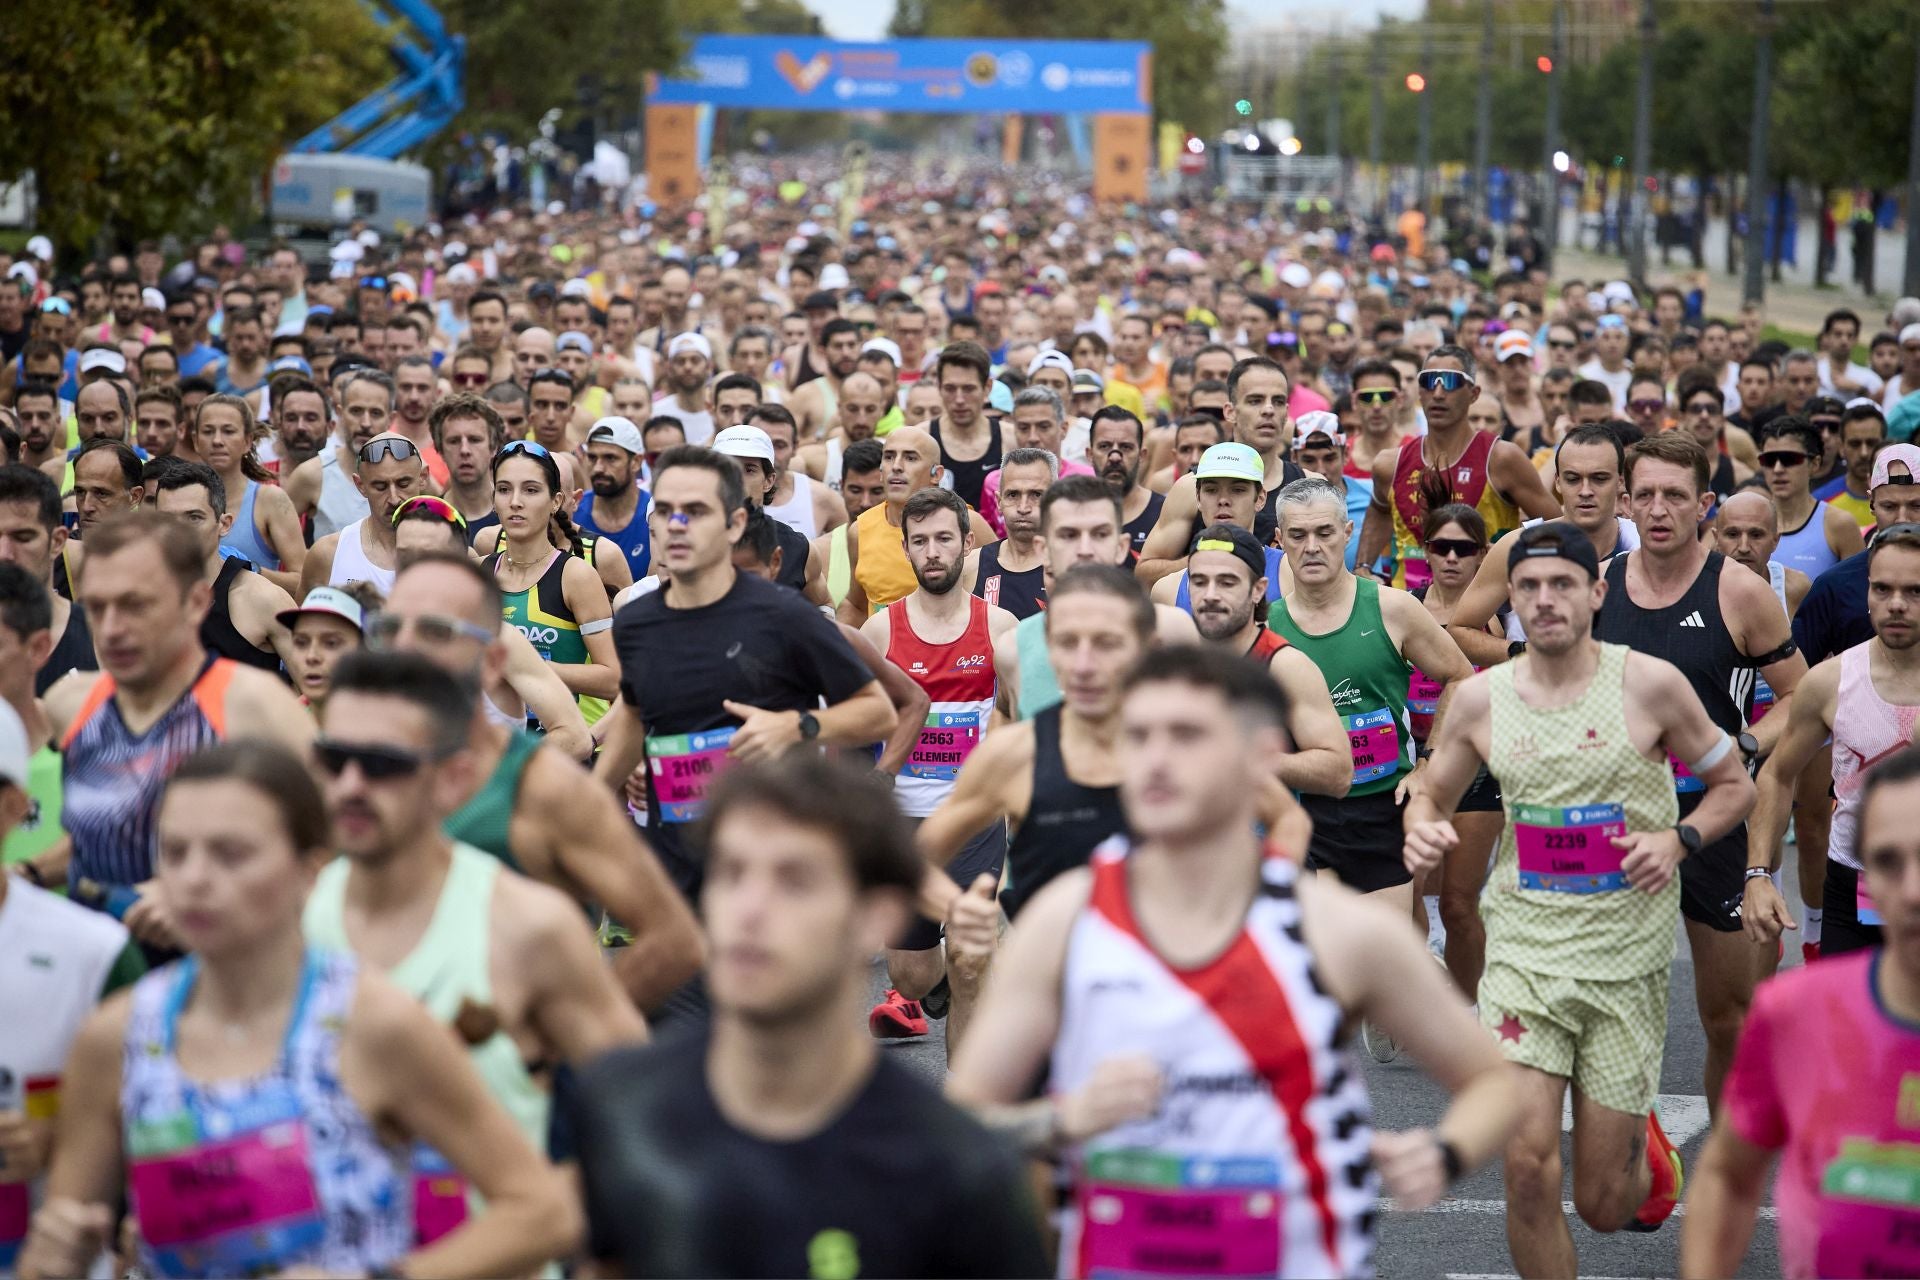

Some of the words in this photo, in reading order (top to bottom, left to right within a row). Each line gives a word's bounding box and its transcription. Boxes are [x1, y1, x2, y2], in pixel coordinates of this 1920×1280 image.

[1366, 715, 1387, 724] ZURICH
[921, 732, 954, 745] 2563
[912, 751, 962, 763] CLEMENT
[1544, 832, 1588, 849] 2239
[1551, 858, 1585, 873] Liam
